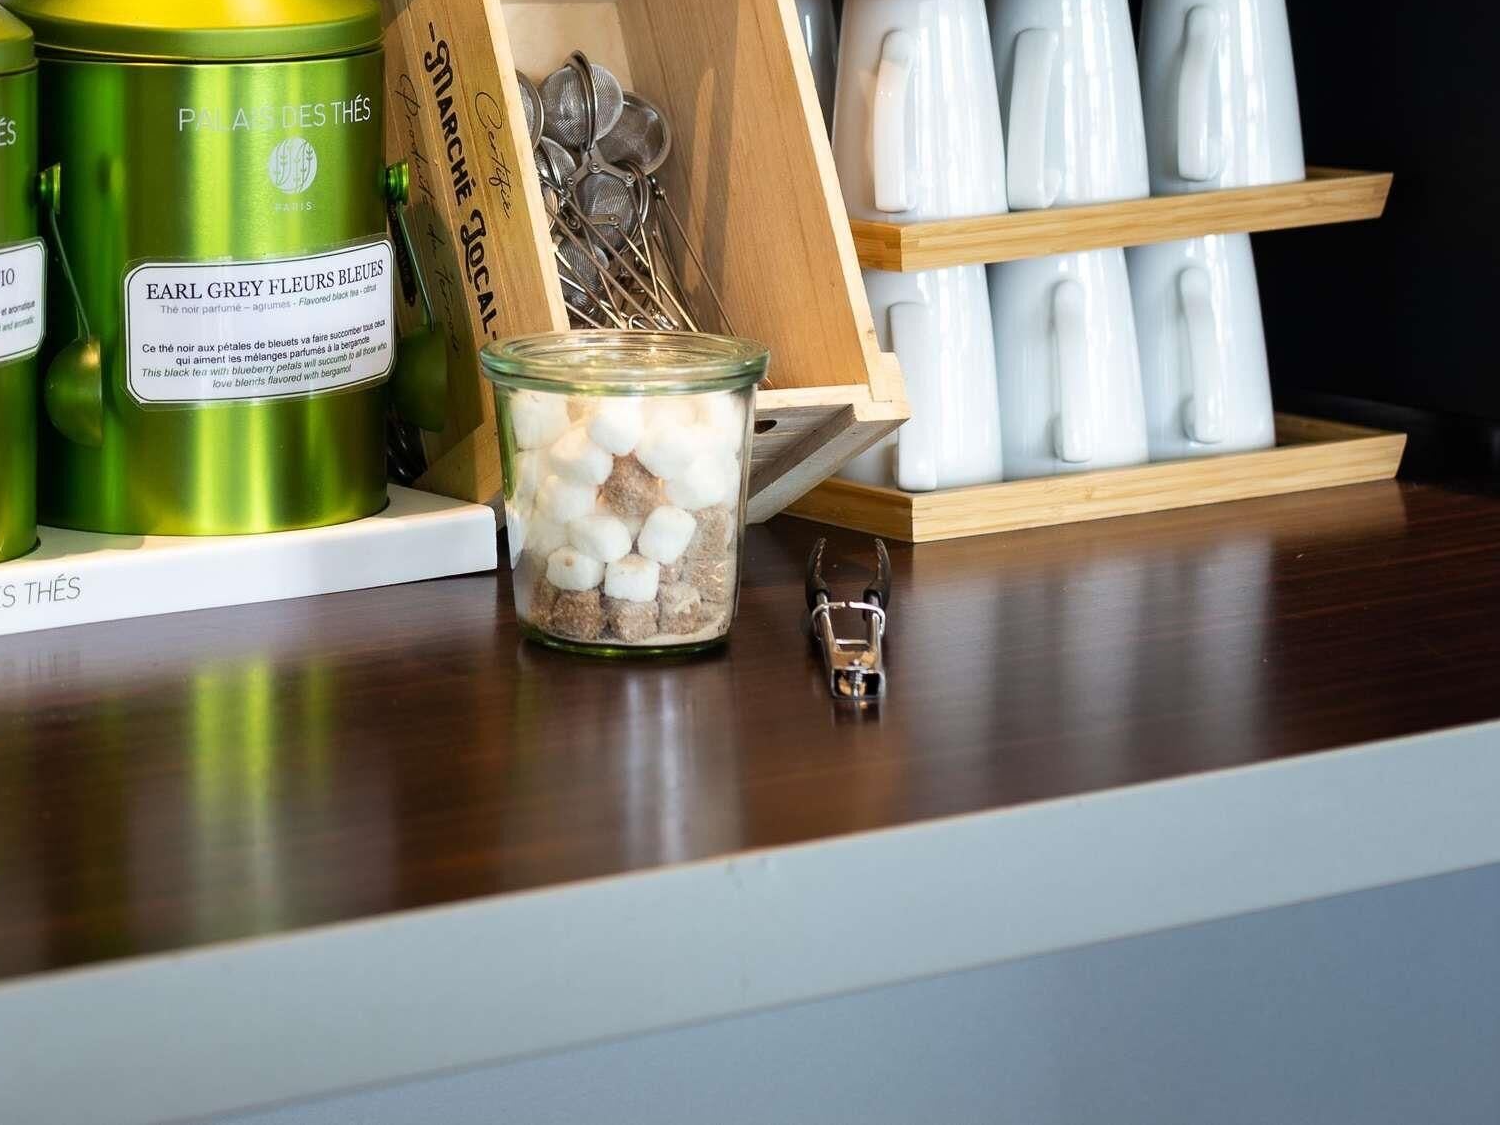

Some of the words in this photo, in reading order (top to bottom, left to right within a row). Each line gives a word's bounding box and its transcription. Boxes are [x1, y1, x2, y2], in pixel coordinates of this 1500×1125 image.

[179, 107, 276, 132] PALAIS
[282, 103, 326, 128] DES
[331, 93, 371, 124] THÉS
[146, 282, 202, 300] EARL
[207, 279, 264, 299] GREY
[269, 271, 335, 295] FLEURS
[338, 259, 385, 286] BLEUES
[161, 304, 179, 315] Thé
[181, 304, 200, 315] noir
[202, 303, 242, 317] parfumé
[252, 300, 291, 314] agrumes
[299, 292, 332, 307] Flavored
[332, 289, 349, 302] black
[142, 343, 156, 354] Ce
[158, 342, 174, 353] thé
[176, 342, 195, 353] noir
[197, 344, 215, 353] aux
[217, 341, 252, 355] pétales
[254, 340, 266, 350] de
[267, 337, 299, 350] bleuets
[300, 336, 311, 346] va
[312, 332, 329, 344] faire
[329, 325, 363, 340] succomber
[176, 354, 191, 366] qui
[193, 353, 226, 365] aiment
[228, 353, 242, 364] les
[244, 350, 288, 365] mélanges
[289, 345, 326, 361] parfumés
[327, 343, 333, 354] à
[333, 341, 340, 352] la
[341, 335, 371, 351] bergamote
[141, 368, 162, 378] This
[164, 368, 190, 378] black
[192, 368, 207, 377] tea
[210, 366, 229, 377] with
[231, 363, 274, 377] blueberry
[276, 359, 302, 374] petals
[303, 357, 317, 370] will
[317, 353, 349, 367] succumb
[355, 349, 363, 360] all
[363, 345, 377, 357] those
[213, 378, 233, 389] love
[235, 376, 266, 388] blends
[267, 372, 302, 386] flavored
[303, 370, 319, 381] with
[24, 573, 81, 605] THÉS
